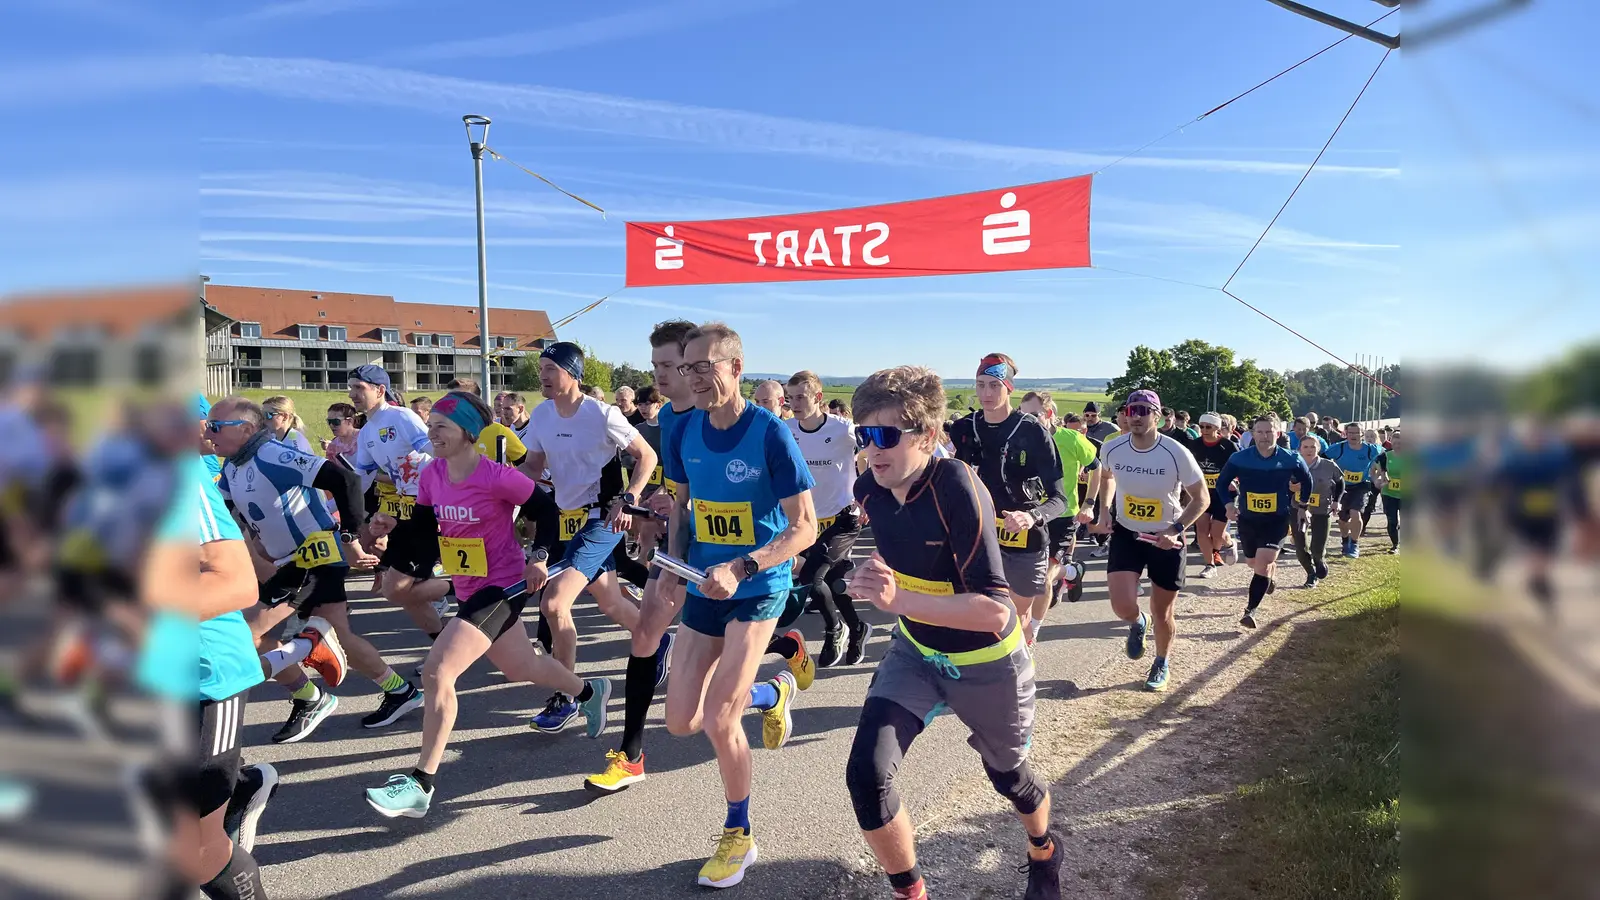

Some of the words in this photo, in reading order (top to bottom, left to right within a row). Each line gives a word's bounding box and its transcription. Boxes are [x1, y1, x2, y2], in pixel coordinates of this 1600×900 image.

[1129, 503, 1155, 517] 252
[1252, 499, 1271, 509] 165
[704, 514, 742, 537] 104
[298, 541, 330, 563] 219
[457, 550, 470, 568] 2
